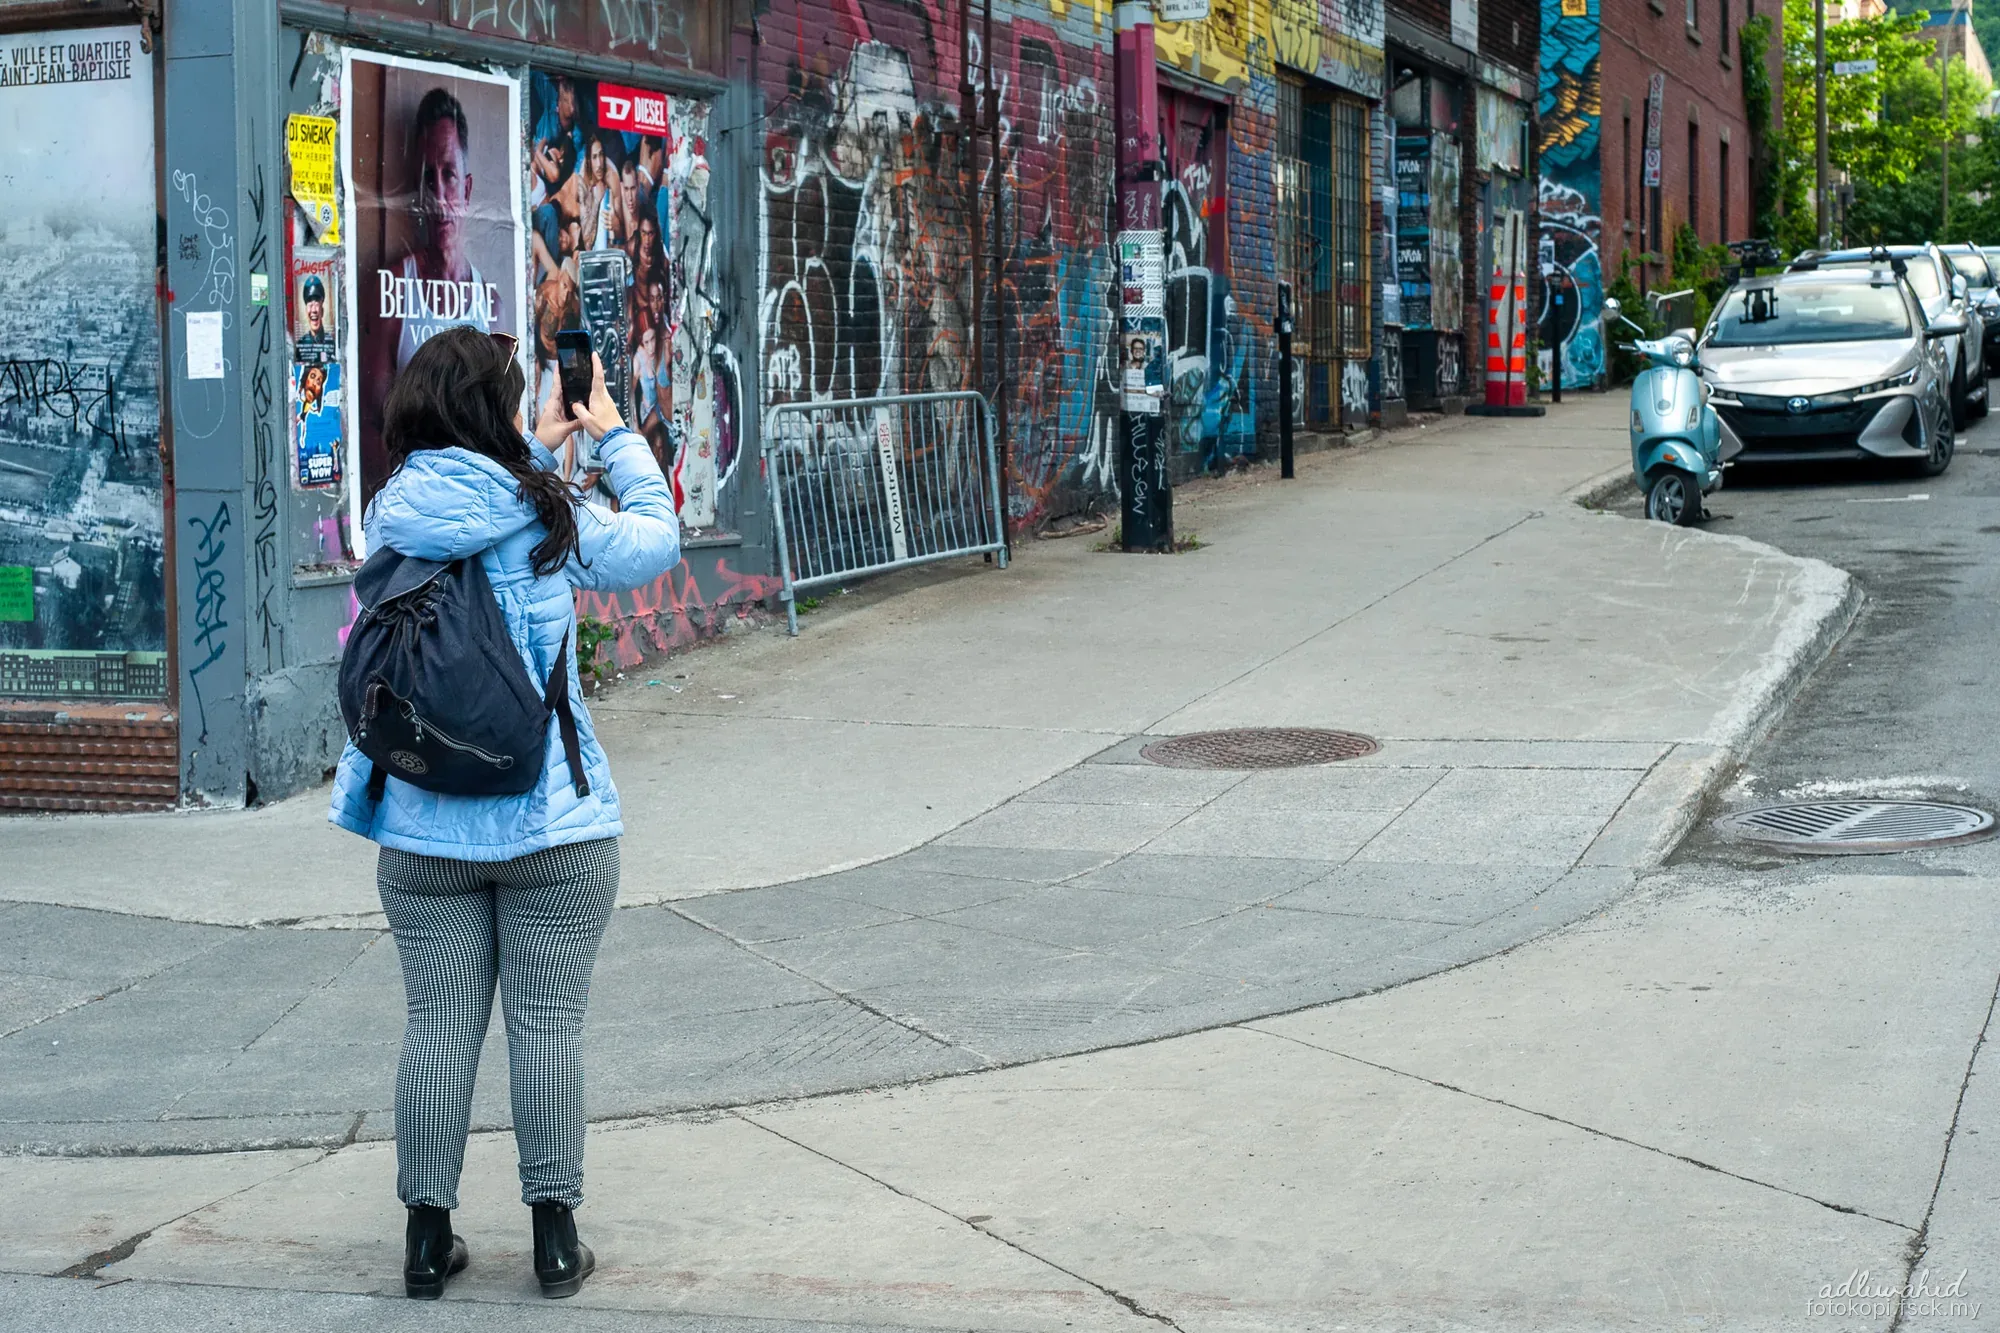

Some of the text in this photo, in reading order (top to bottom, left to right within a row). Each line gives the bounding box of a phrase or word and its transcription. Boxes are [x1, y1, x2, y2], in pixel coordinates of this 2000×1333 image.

[11, 46, 46, 66] VILLE
[50, 45, 65, 64] ET
[68, 40, 131, 63] QUARTIER
[0, 59, 131, 85] AINT-JEAN-BAPTISTE
[634, 96, 666, 127] DIESEL
[300, 124, 333, 146] SNEAK
[377, 269, 498, 328] BELVEDERE
[308, 456, 332, 469] SUPER
[310, 467, 332, 479] WOW
[883, 450, 901, 533] Montréal
